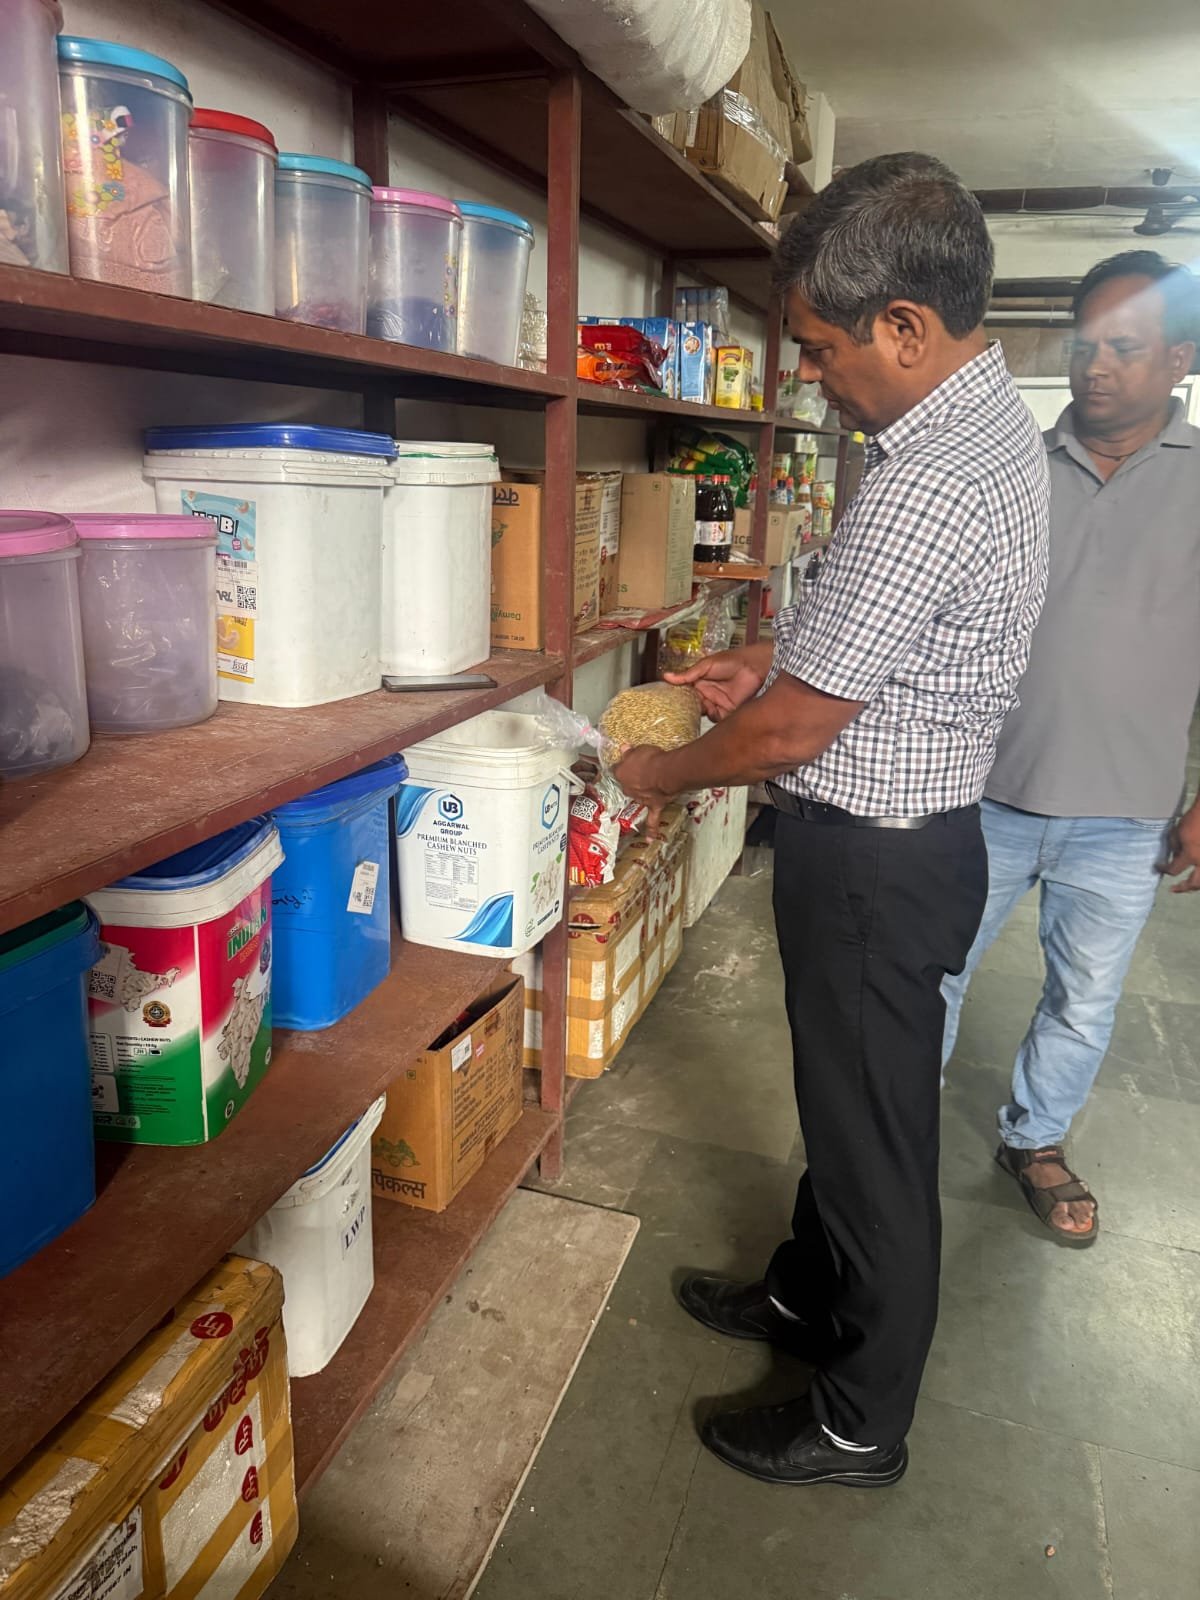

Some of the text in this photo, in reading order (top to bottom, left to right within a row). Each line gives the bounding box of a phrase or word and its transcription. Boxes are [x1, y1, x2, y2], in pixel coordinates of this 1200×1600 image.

[192, 510, 240, 538] B!
[734, 535, 752, 545] ICE
[433, 820, 470, 830] AGGARWAL
[440, 828, 463, 836] GROUP
[417, 833, 487, 849] PREMIUM BLANCHED
[427, 842, 477, 855] CASHEW NUTS
